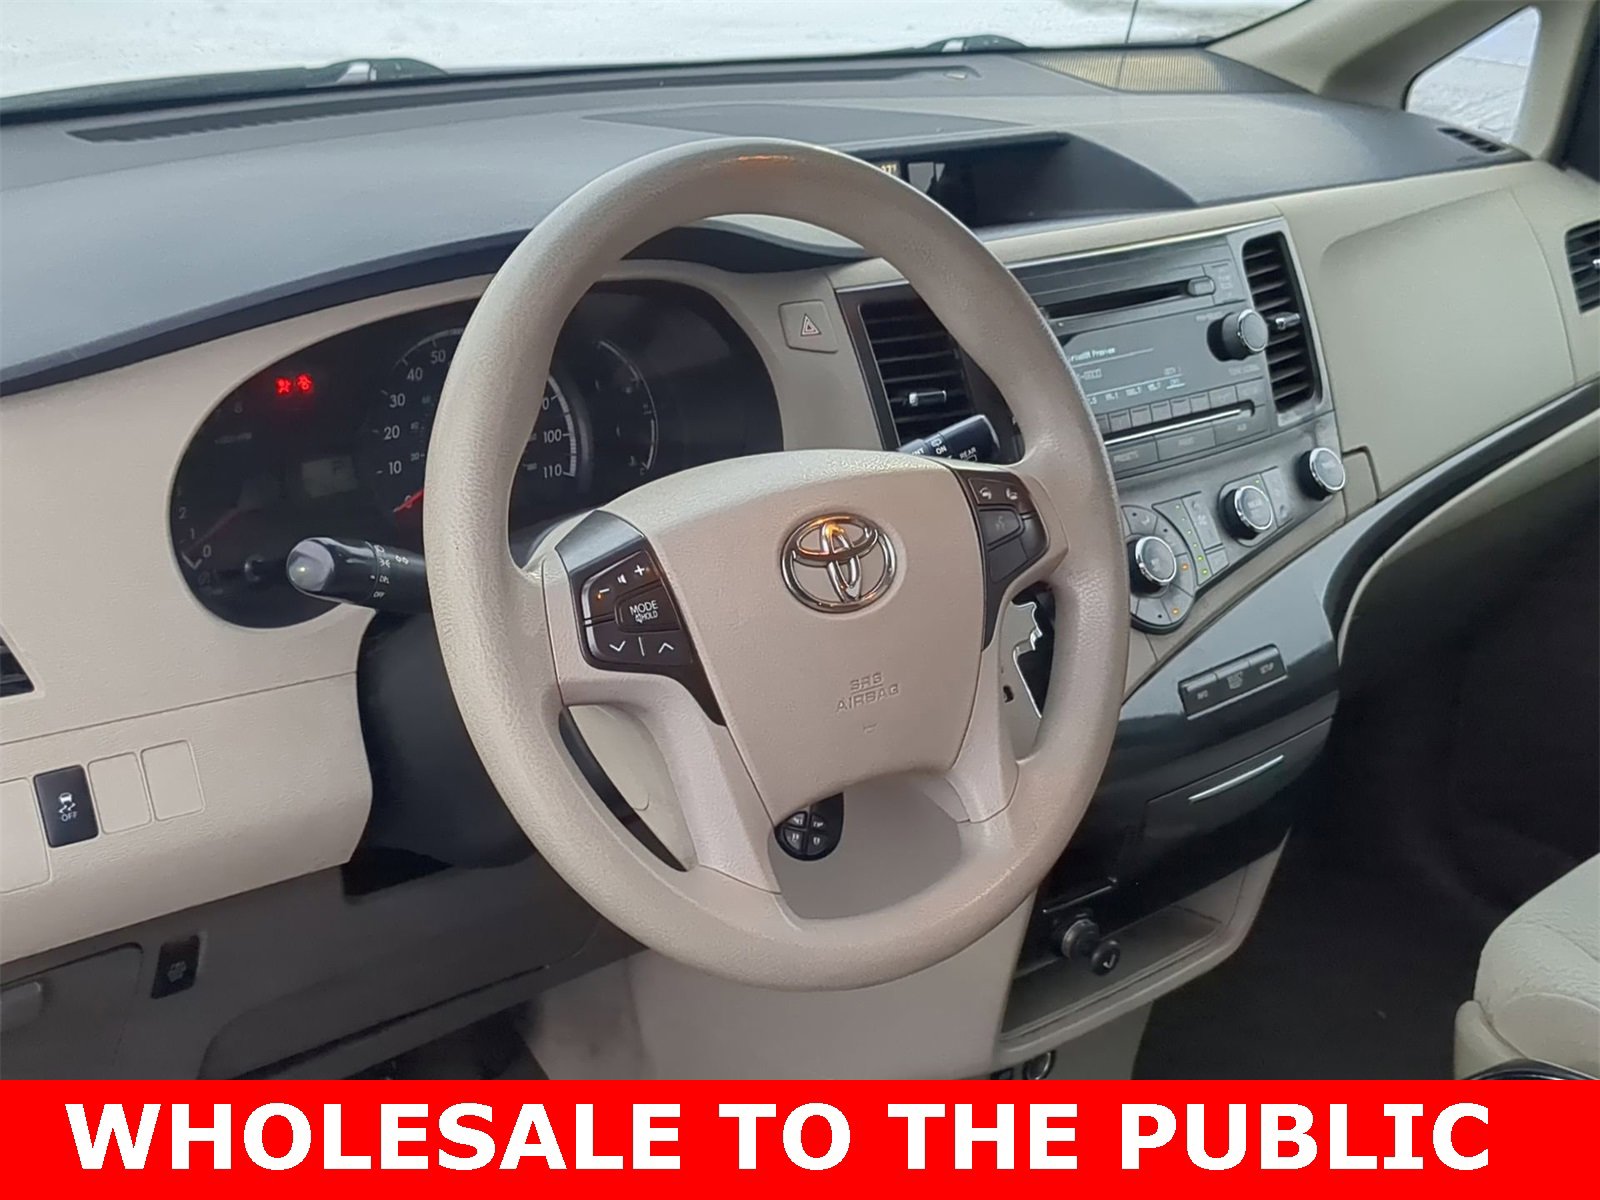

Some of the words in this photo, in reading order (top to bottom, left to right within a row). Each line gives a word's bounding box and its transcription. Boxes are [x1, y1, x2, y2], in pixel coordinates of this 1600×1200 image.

[430, 349, 446, 364] 50
[406, 366, 423, 381] 40
[389, 393, 406, 408] 30
[384, 425, 400, 440] 20
[543, 428, 562, 443] 100
[959, 446, 977, 460] REAR
[388, 460, 402, 475] 10
[543, 463, 562, 479] 110
[179, 506, 187, 520] 2
[203, 544, 212, 558] 0
[629, 600, 659, 615] MODE
[641, 610, 659, 621] HOLD
[850, 672, 882, 690] SRS
[836, 683, 899, 712] AIRBAG
[61, 811, 77, 822] OFF
